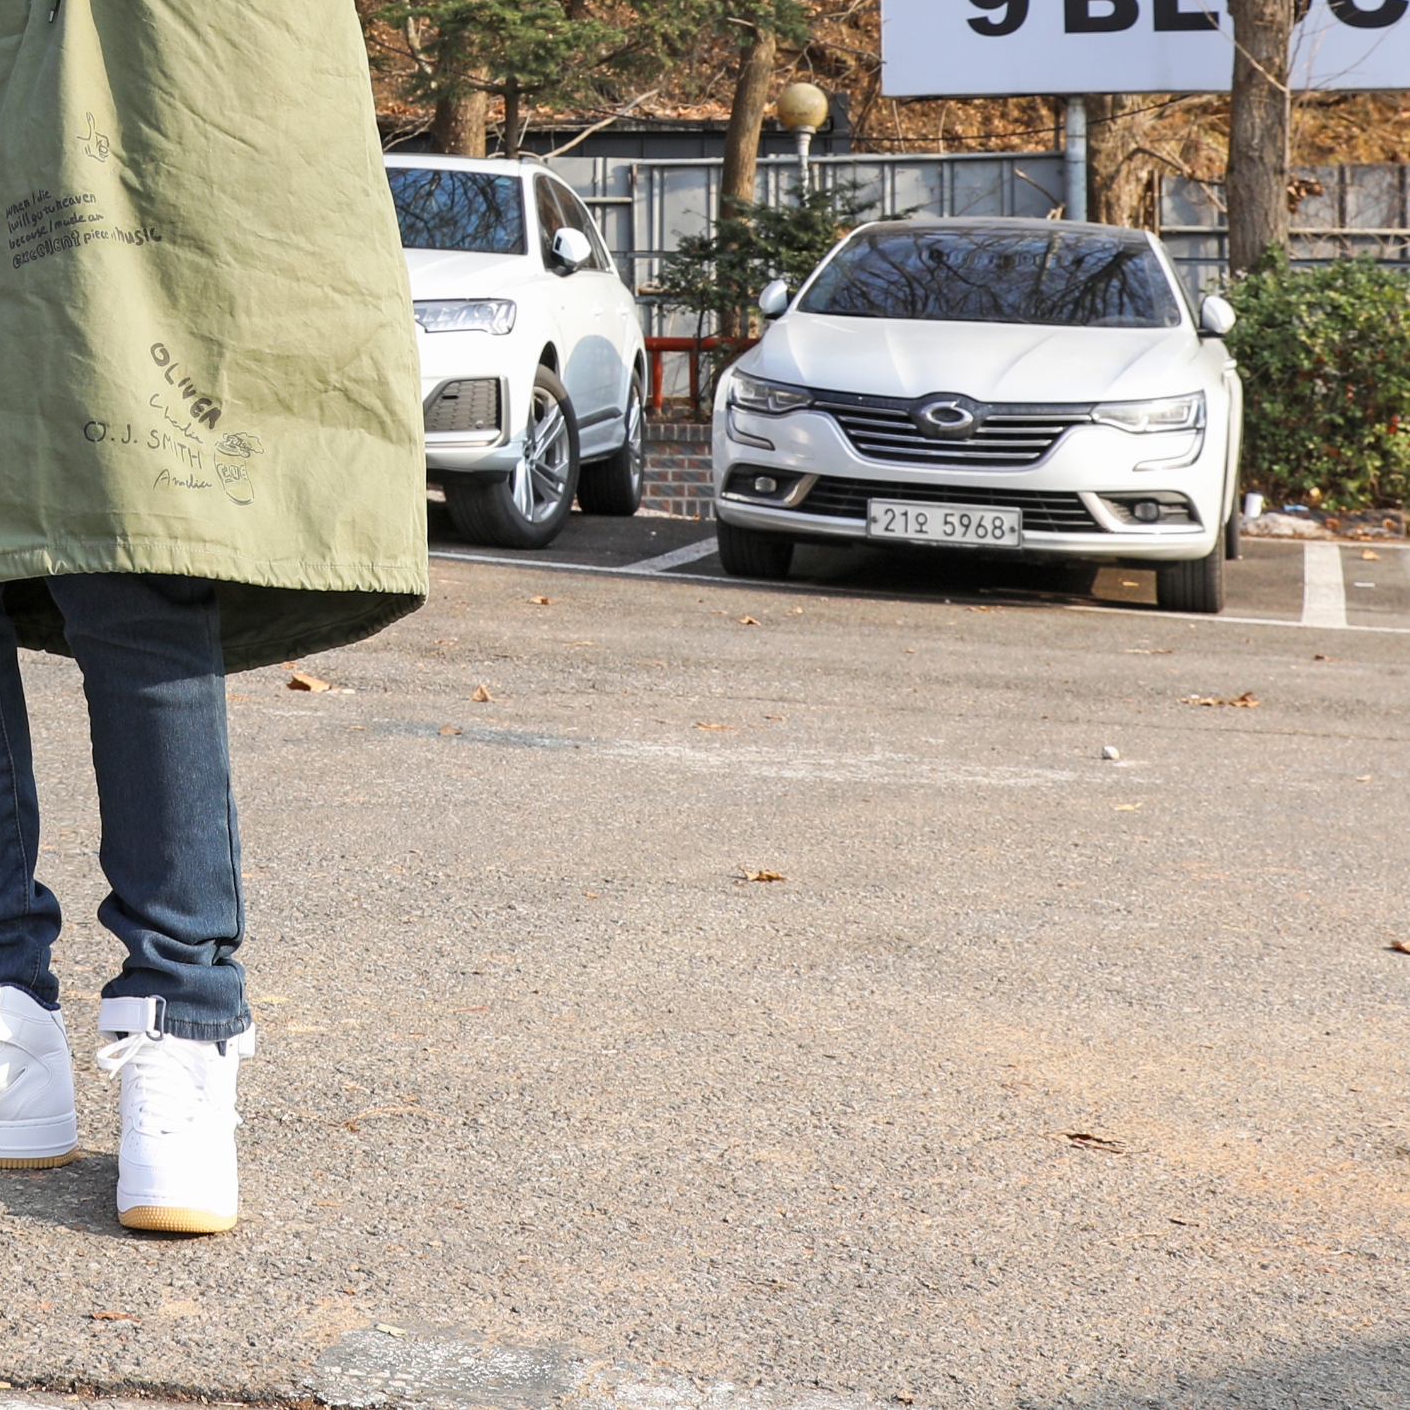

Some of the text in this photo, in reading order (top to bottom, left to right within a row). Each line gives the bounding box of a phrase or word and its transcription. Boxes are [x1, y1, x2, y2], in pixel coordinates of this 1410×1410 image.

[150, 342, 222, 430] OLIVER
[147, 429, 203, 470] SMITH
[883, 508, 1006, 540] 21오 5968
